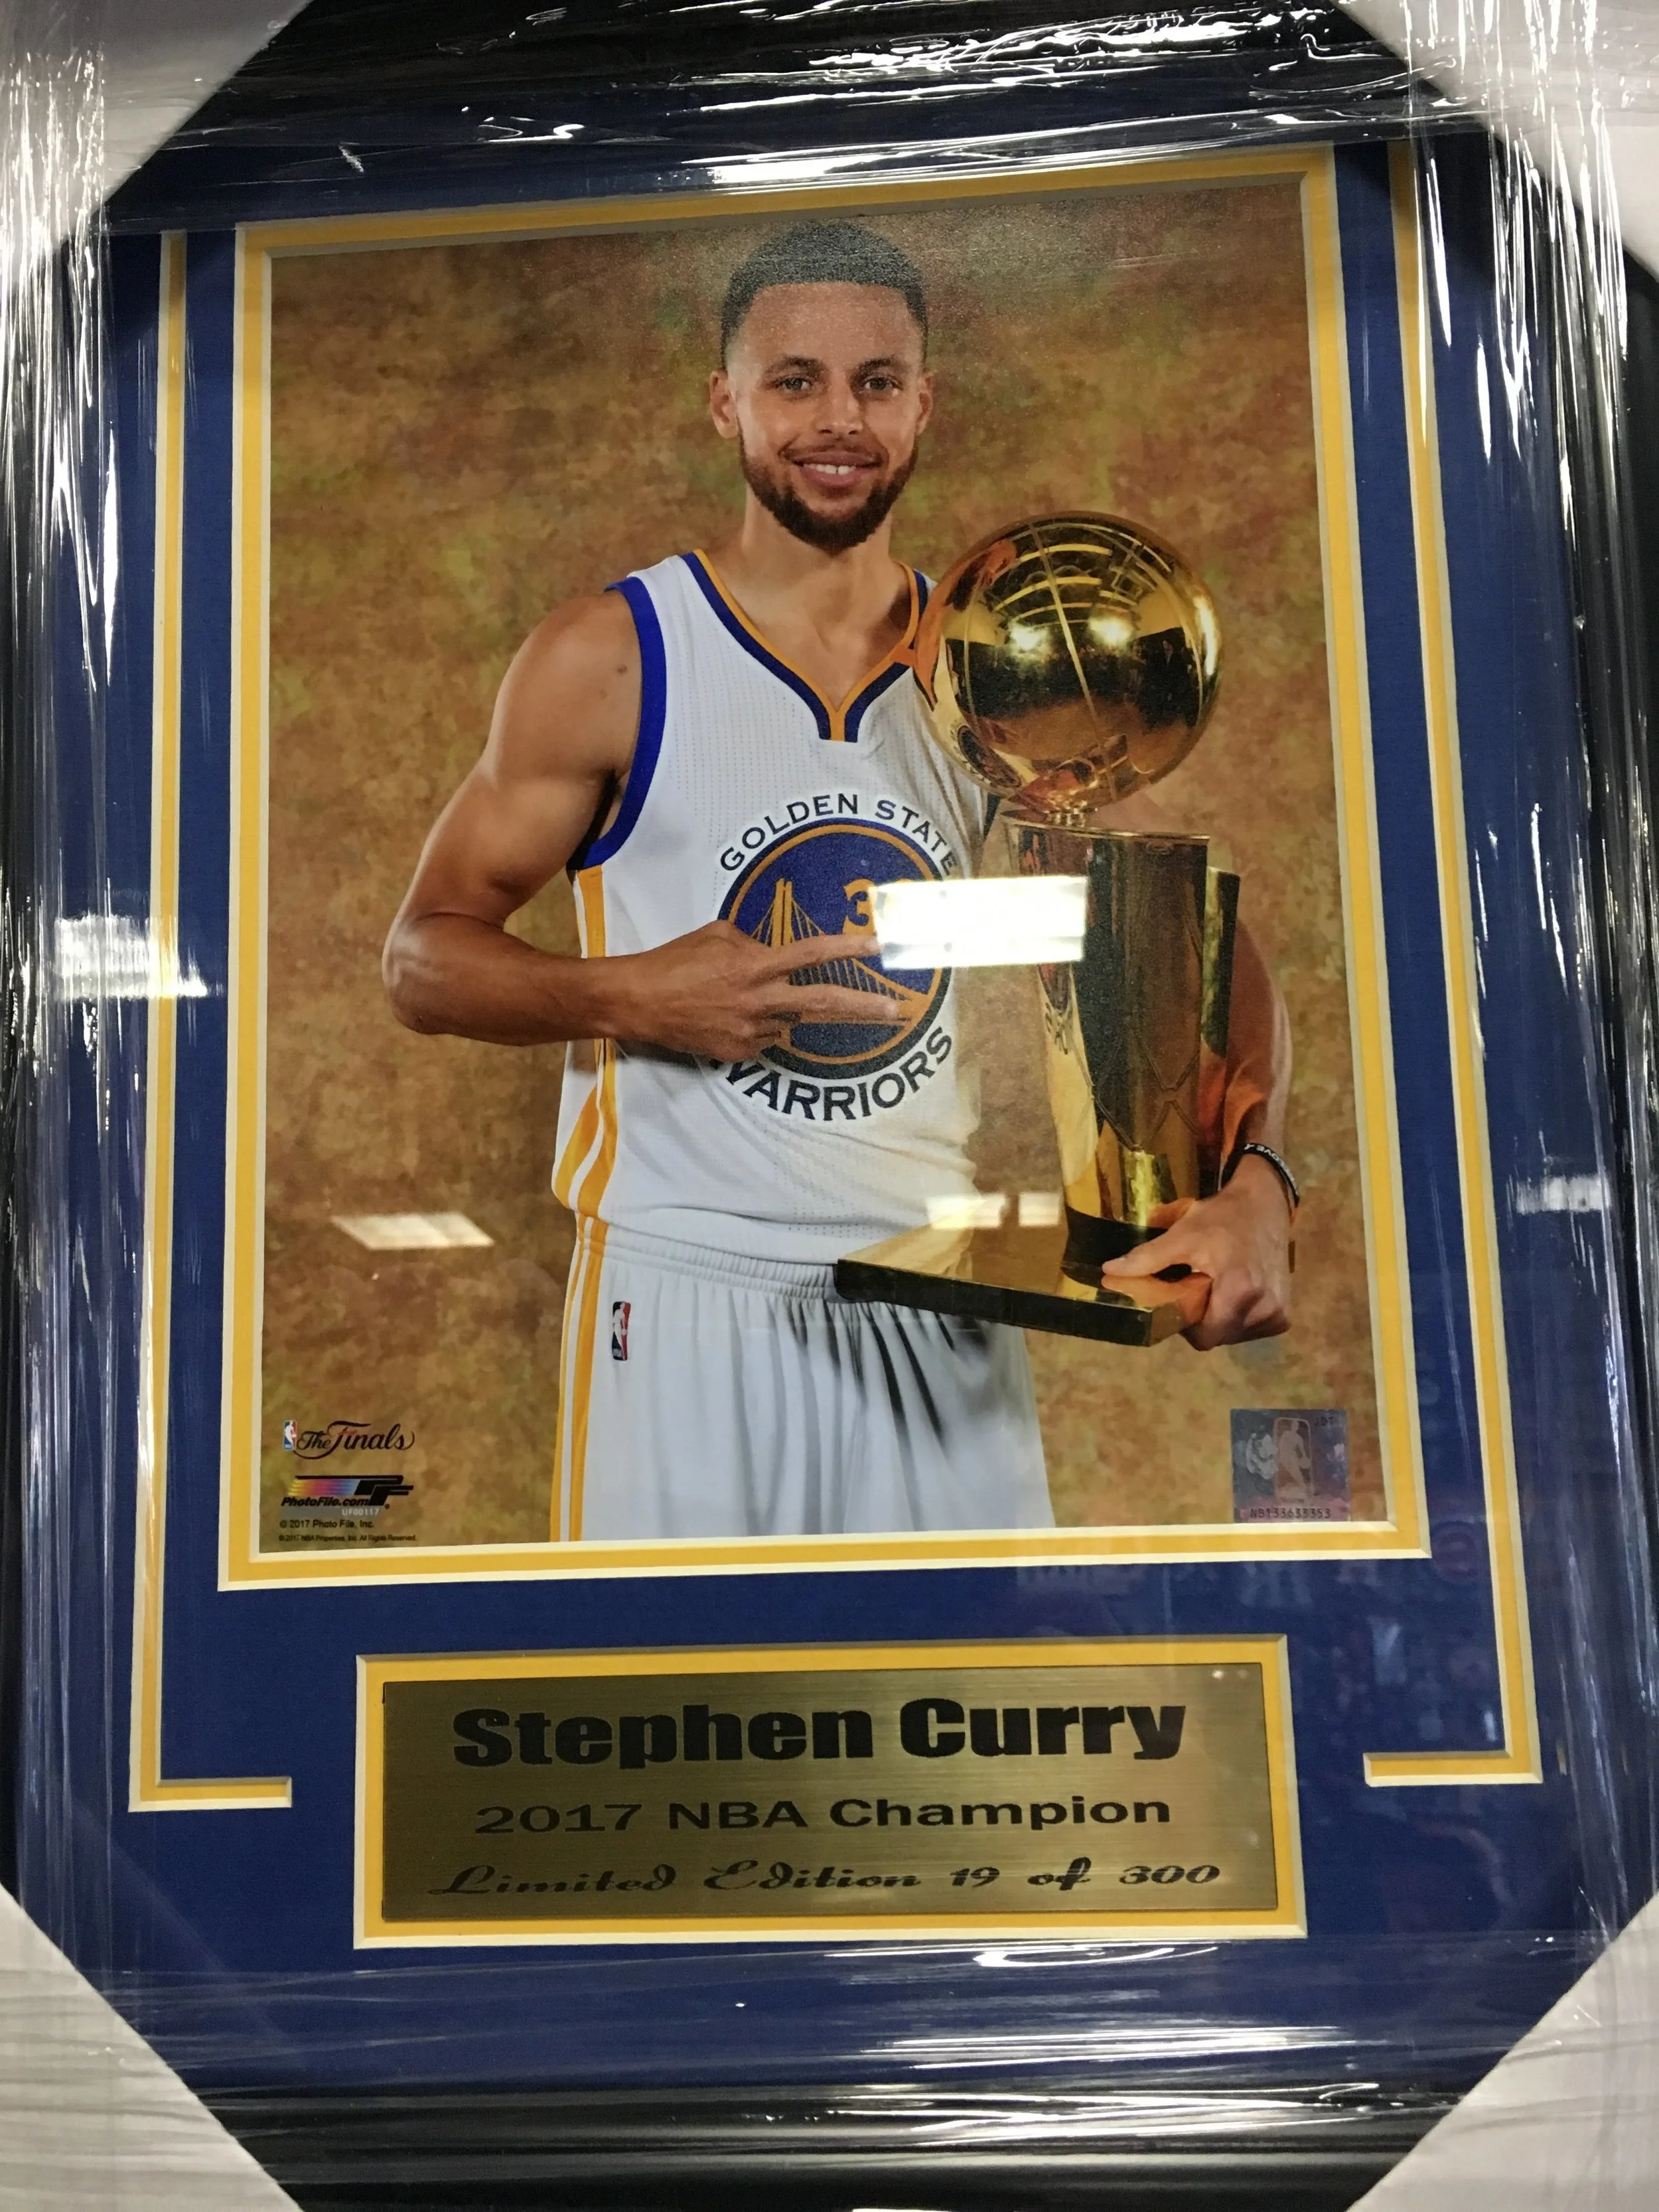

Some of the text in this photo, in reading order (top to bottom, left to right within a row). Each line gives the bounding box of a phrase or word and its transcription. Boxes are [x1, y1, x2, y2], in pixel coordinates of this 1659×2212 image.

[720, 793, 958, 876] GOLDEN STATE
[293, 1420, 415, 1460] The Finals
[281, 1497, 369, 1507] PhotoFile.com
[289, 1520, 310, 1528] 2017
[313, 1519, 337, 1528] Photo
[360, 1519, 374, 1528] Inc.
[453, 1698, 1187, 1769] Stephen Curry
[475, 1796, 1171, 1834] 2017 NBA Champion
[428, 1857, 1220, 1894] Limited Edition 19 of 300
